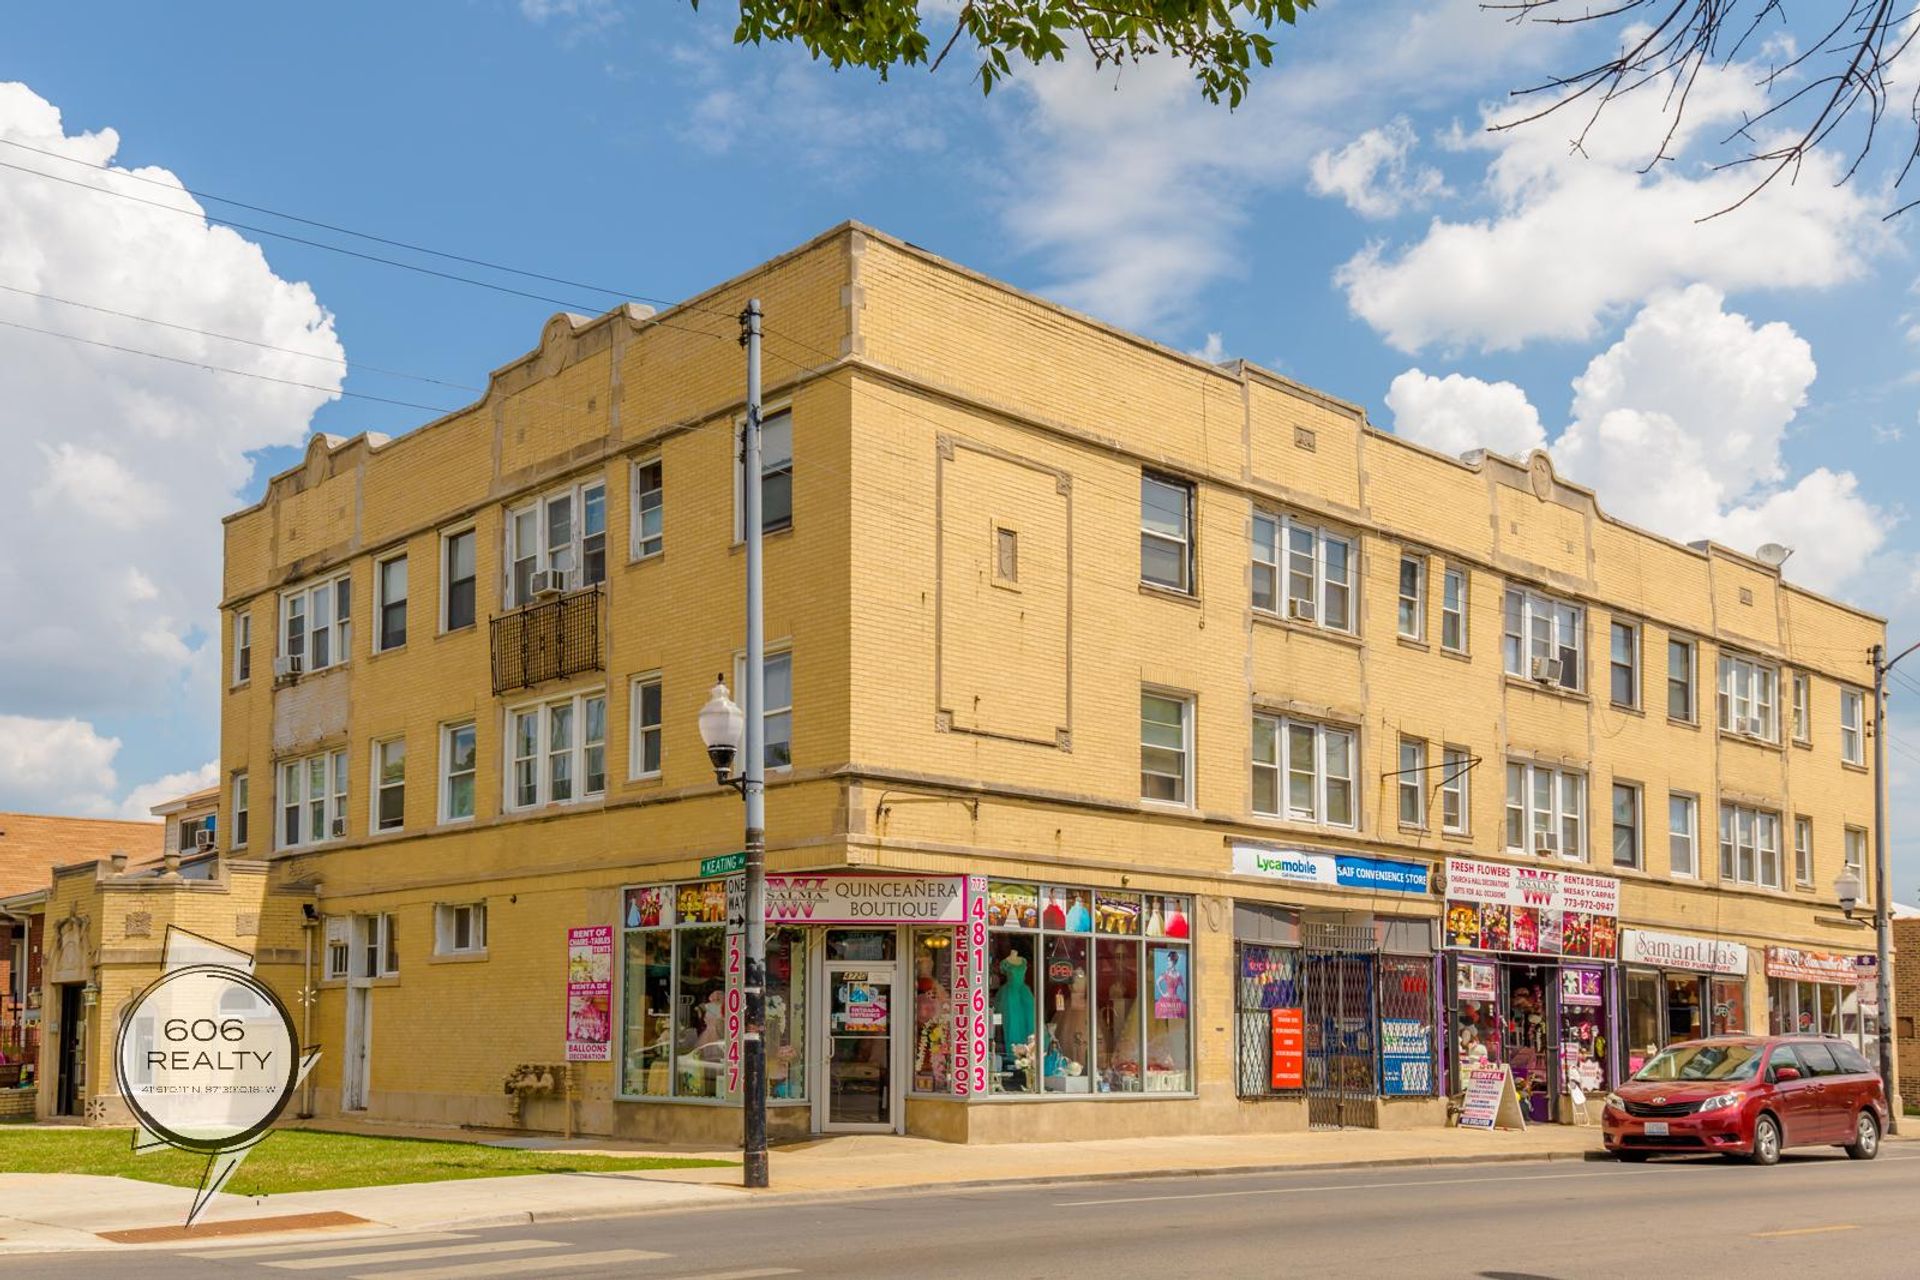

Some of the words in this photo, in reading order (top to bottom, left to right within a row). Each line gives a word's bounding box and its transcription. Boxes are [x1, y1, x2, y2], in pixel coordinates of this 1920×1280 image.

[707, 855, 737, 873] KEATING
[1256, 855, 1316, 875] Lycamobile
[1451, 861, 1475, 873] FRESH
[1477, 864, 1511, 878] FLOWERS
[1337, 866, 1356, 878] SAIF
[1356, 867, 1404, 883] CONVENIENCE
[1405, 874, 1427, 886] STORE
[1564, 875, 1585, 886] RENTA
[1586, 878, 1594, 887] DE
[1595, 880, 1616, 889] SILLAS
[729, 877, 746, 894] ONE
[835, 879, 958, 897] QUINCEAÑERA
[971, 878, 986, 891] 773
[1564, 887, 1584, 897] MESAS
[1591, 890, 1616, 900] CARPAS
[729, 895, 747, 911] WAY
[851, 902, 938, 918] BOUTIQUE
[1564, 898, 1615, 911] 773-972-0947
[574, 929, 594, 938] RENT
[596, 928, 607, 937] OF
[1637, 931, 1738, 966] Samantha's
[955, 925, 968, 989] RENTA
[1050, 965, 1073, 977] OPEN
[1692, 962, 1731, 972] FURNITURE
[569, 1044, 607, 1053] BALLOONS
[955, 1004, 969, 1095] TUXEDOS
[1473, 1071, 1502, 1080] RENTAL
